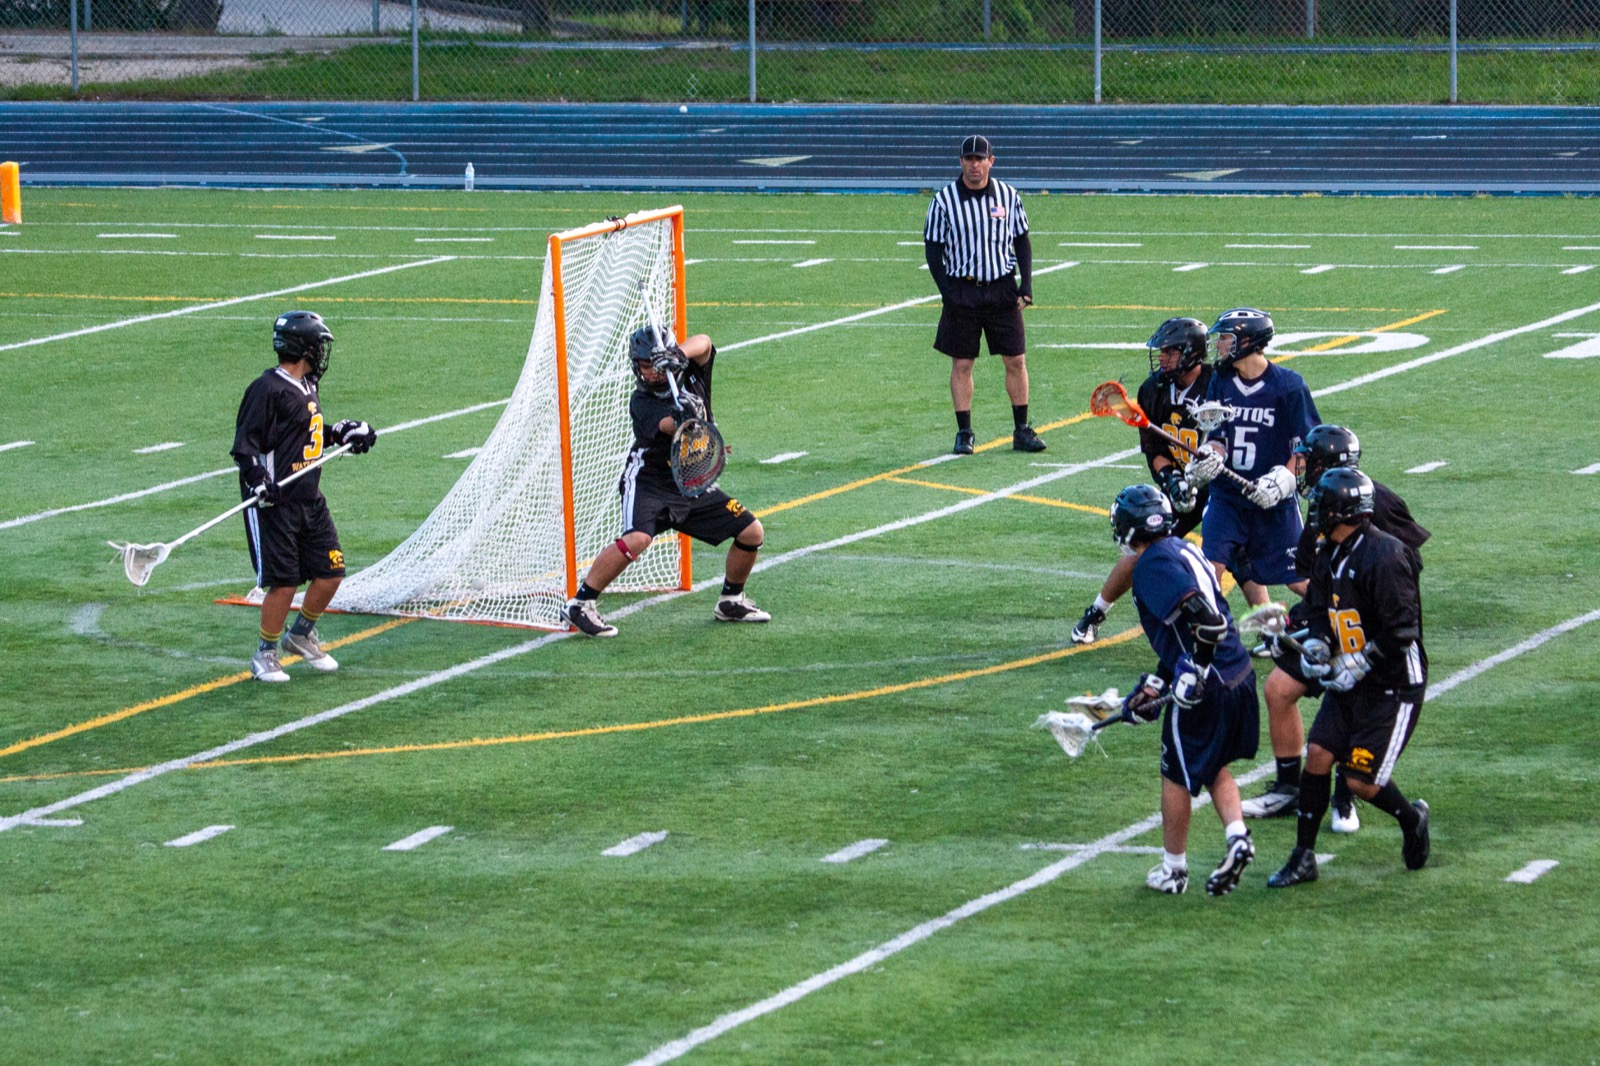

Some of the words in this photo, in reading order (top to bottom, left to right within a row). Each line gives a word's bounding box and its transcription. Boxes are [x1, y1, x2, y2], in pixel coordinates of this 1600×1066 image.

[303, 413, 323, 460] 3
[1228, 406, 1275, 427] PTOS
[1232, 426, 1259, 471] 5
